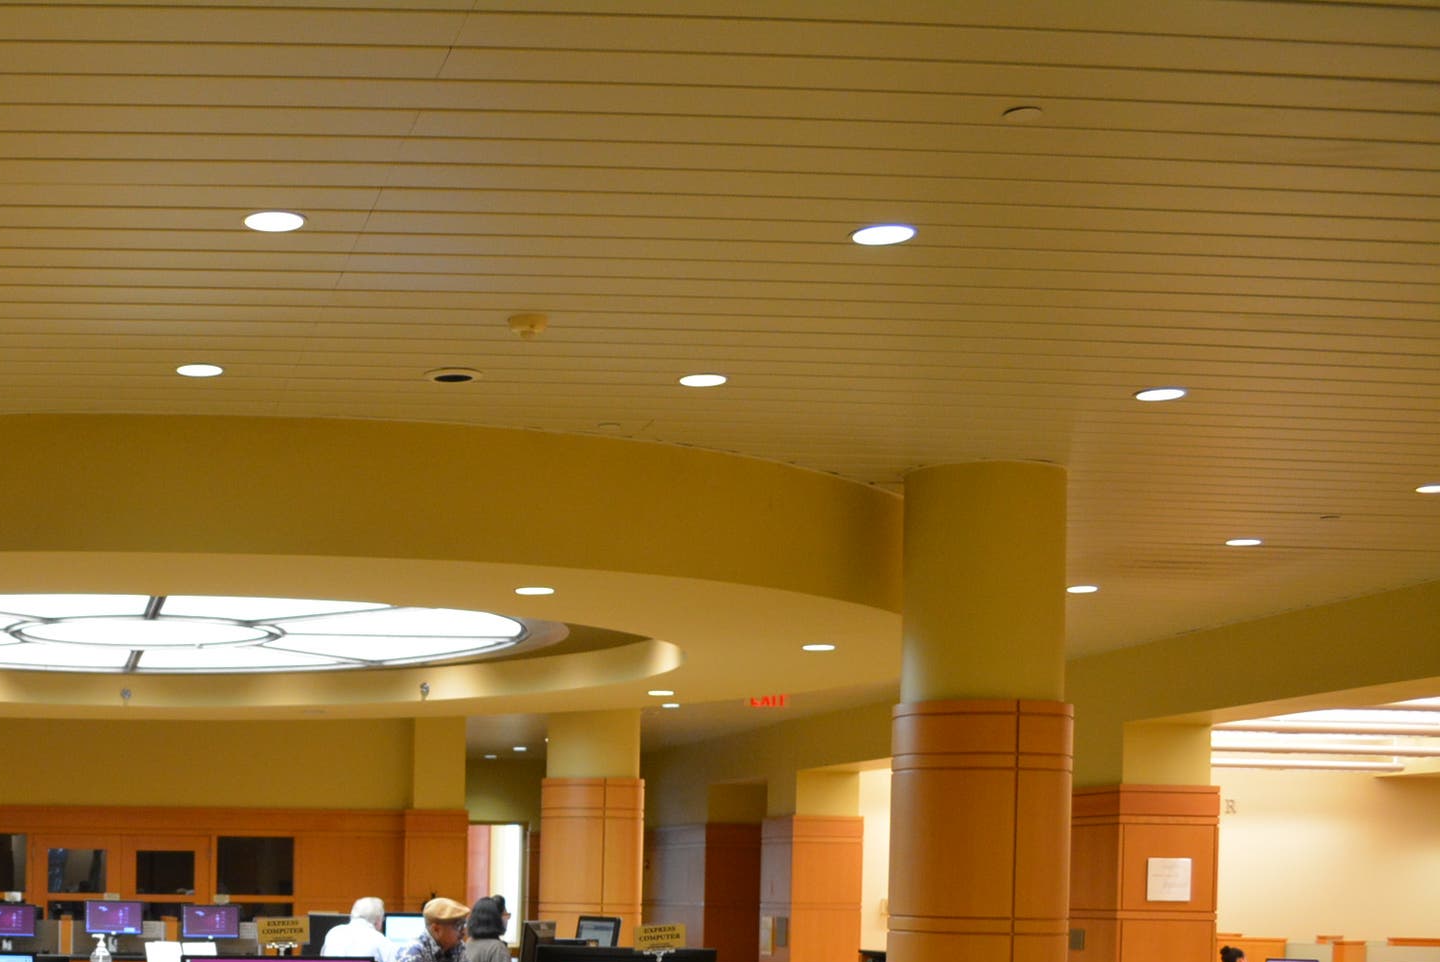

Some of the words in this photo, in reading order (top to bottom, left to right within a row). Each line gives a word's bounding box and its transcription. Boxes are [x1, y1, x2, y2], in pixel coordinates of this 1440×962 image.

[266, 919, 299, 927] EXPRESS
[262, 927, 304, 935] COMPUTER
[644, 926, 676, 934] EXPRESS
[638, 933, 681, 942] COMPUTER
